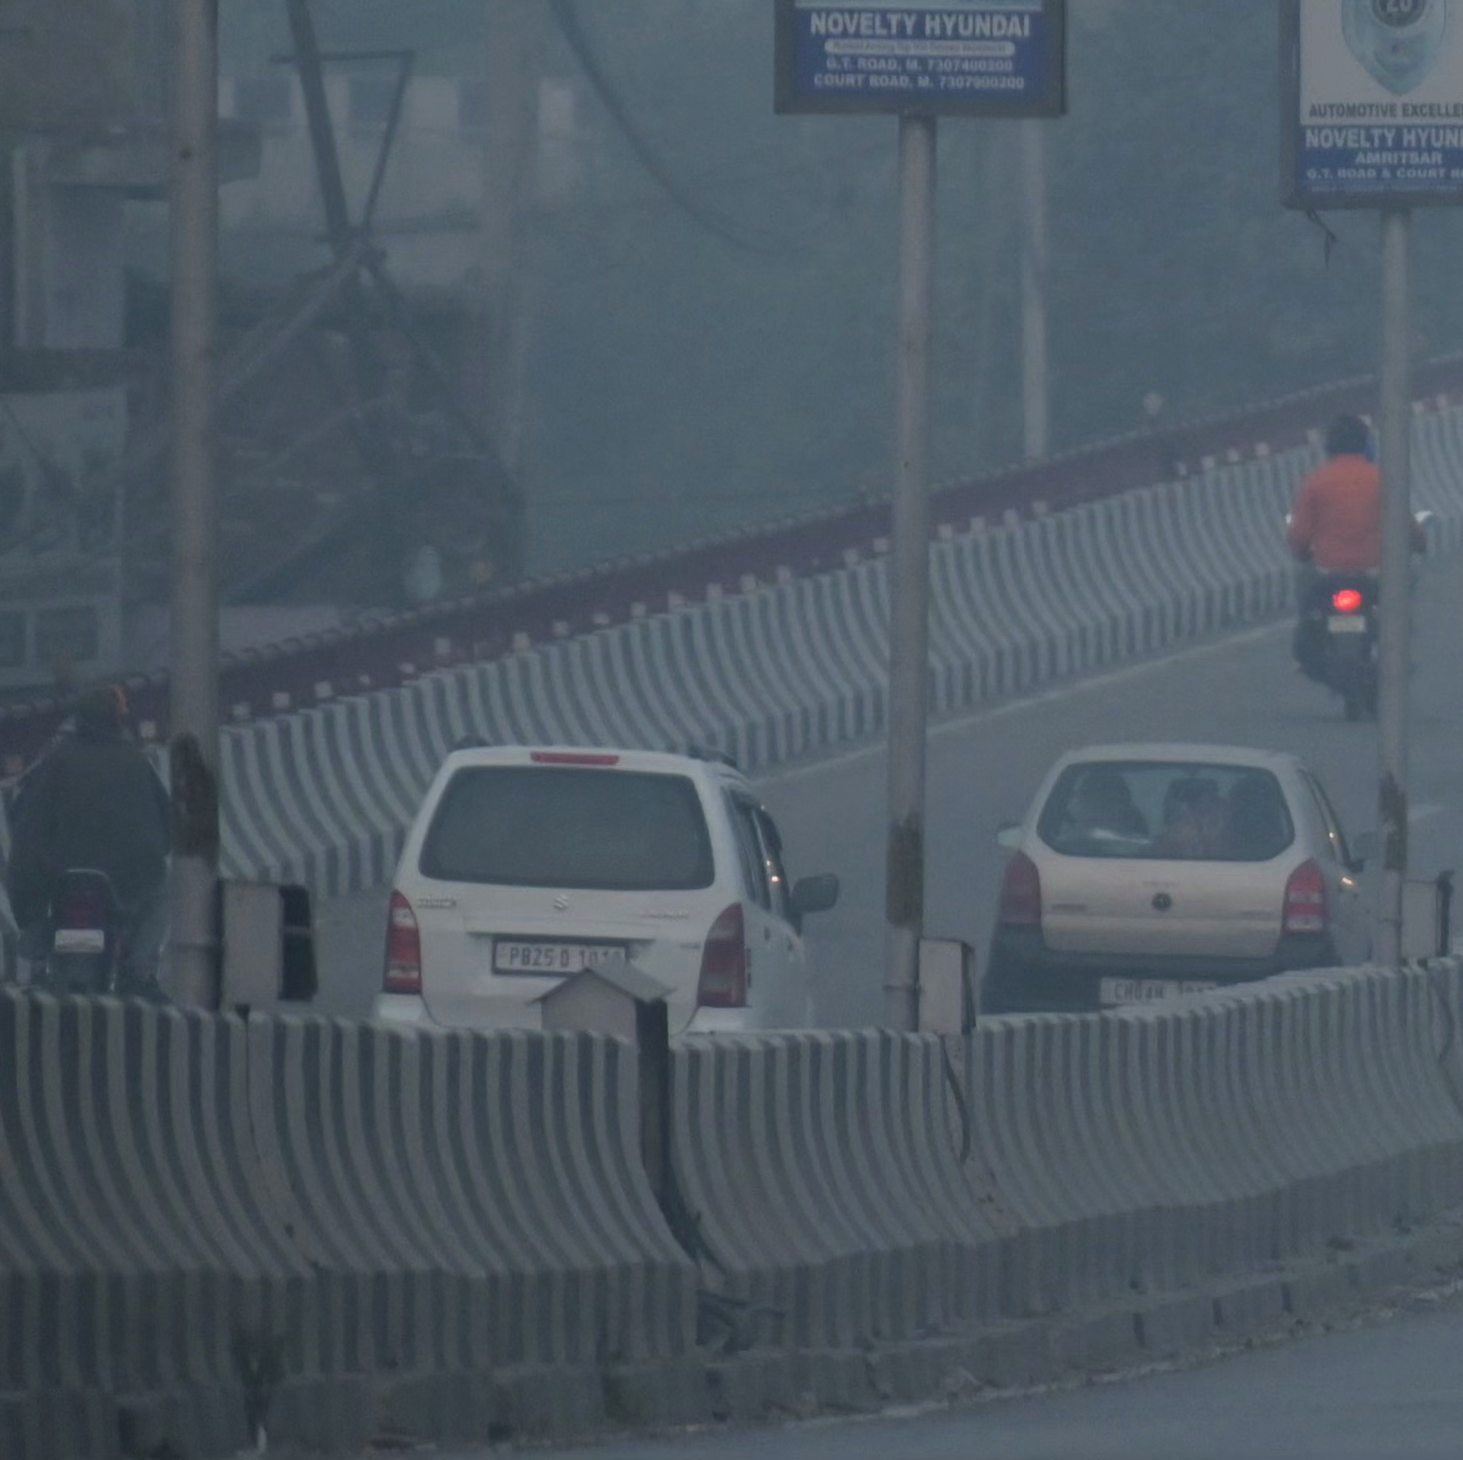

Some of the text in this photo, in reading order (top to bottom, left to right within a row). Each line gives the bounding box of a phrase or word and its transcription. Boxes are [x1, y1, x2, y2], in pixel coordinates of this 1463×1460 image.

[810, 11, 1031, 38] NOVELTY HYUNDAI
[813, 72, 864, 87] COURT
[1309, 103, 1398, 119] AUTOMOTIVE
[1305, 127, 1397, 149] NOVELTY
[1355, 151, 1443, 165] AMRITSAR
[1337, 168, 1377, 180] ROAD
[1396, 167, 1446, 180] COURT
[509, 946, 554, 967] PB25
